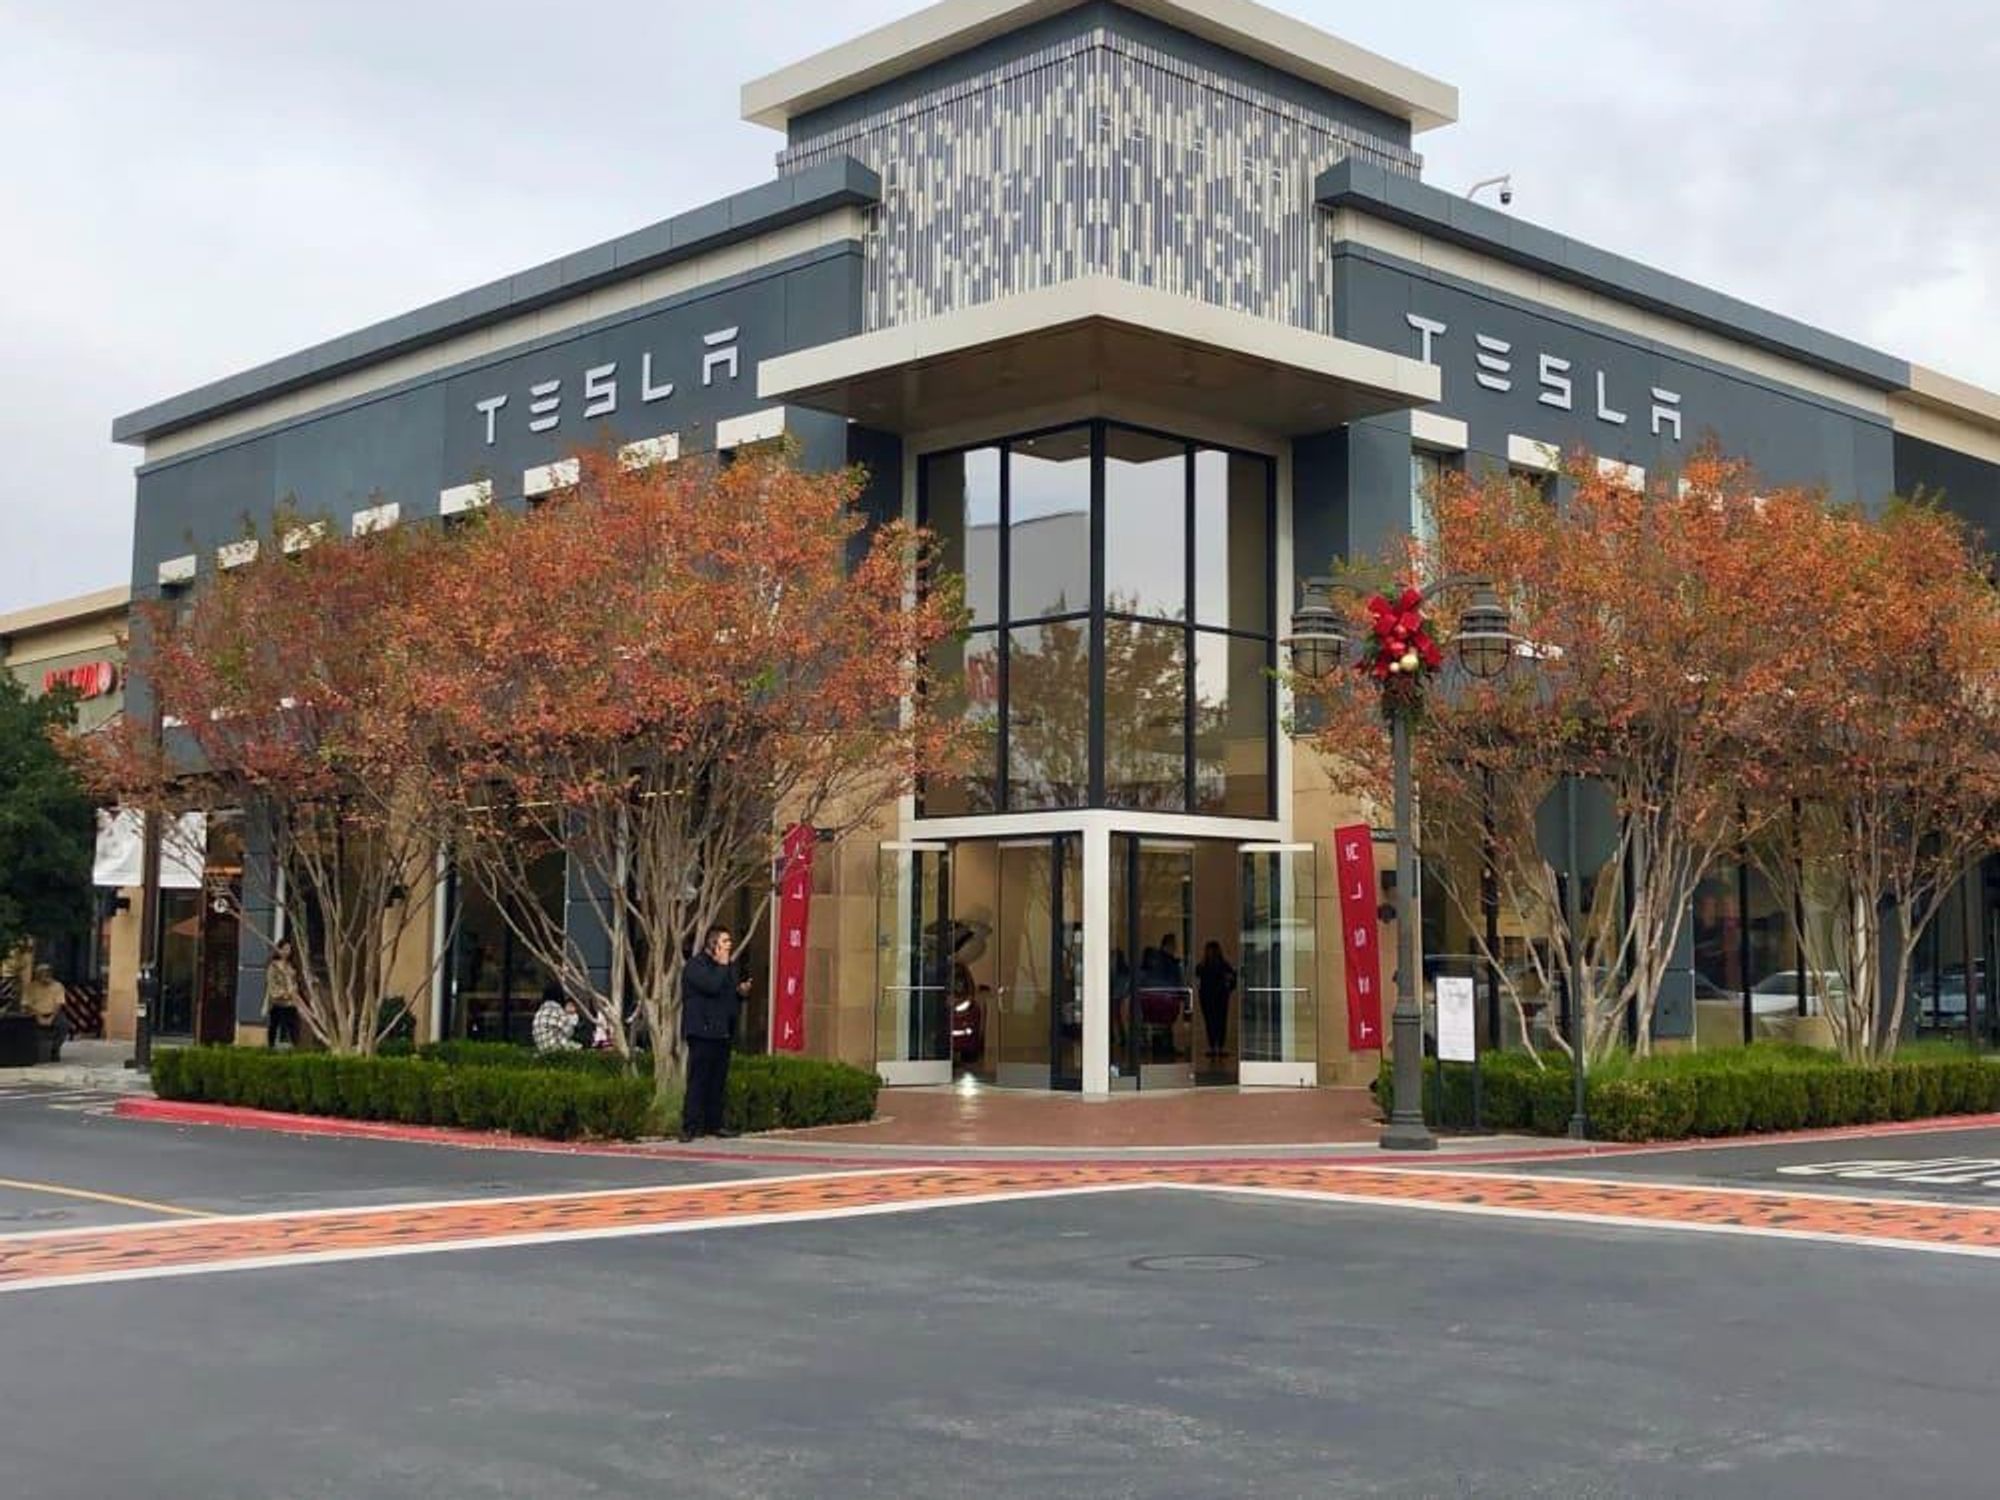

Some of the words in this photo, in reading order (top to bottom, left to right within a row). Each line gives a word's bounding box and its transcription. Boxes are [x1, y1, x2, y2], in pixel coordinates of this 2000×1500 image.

[476, 325, 739, 444] TESLA
[1406, 312, 1682, 441] TESLA
[1345, 842, 1373, 1039] TESLA
